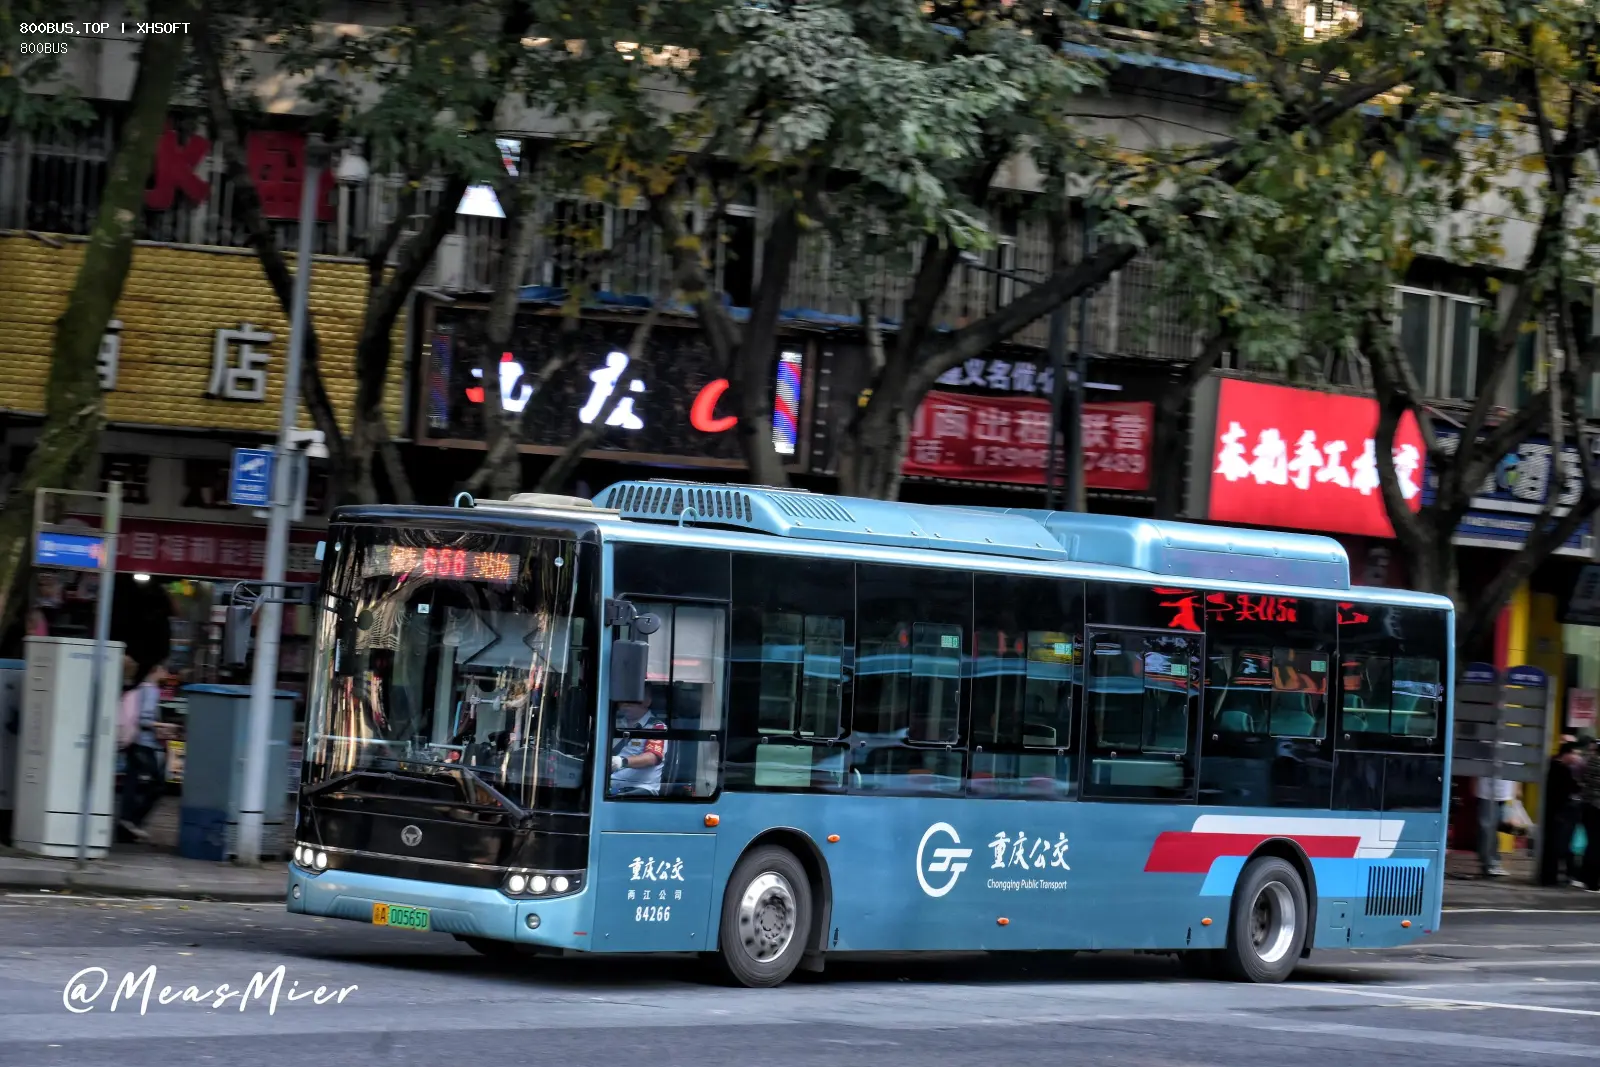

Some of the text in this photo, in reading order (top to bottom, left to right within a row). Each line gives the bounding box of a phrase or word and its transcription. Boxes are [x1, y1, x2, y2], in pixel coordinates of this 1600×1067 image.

[988, 831, 1071, 871] 重庆公交
[628, 856, 685, 882] 重庆公交
[987, 878, 1067, 891] Chongqing Public Transport
[627, 889, 682, 901] 两江公司
[635, 906, 671, 922] 84266
